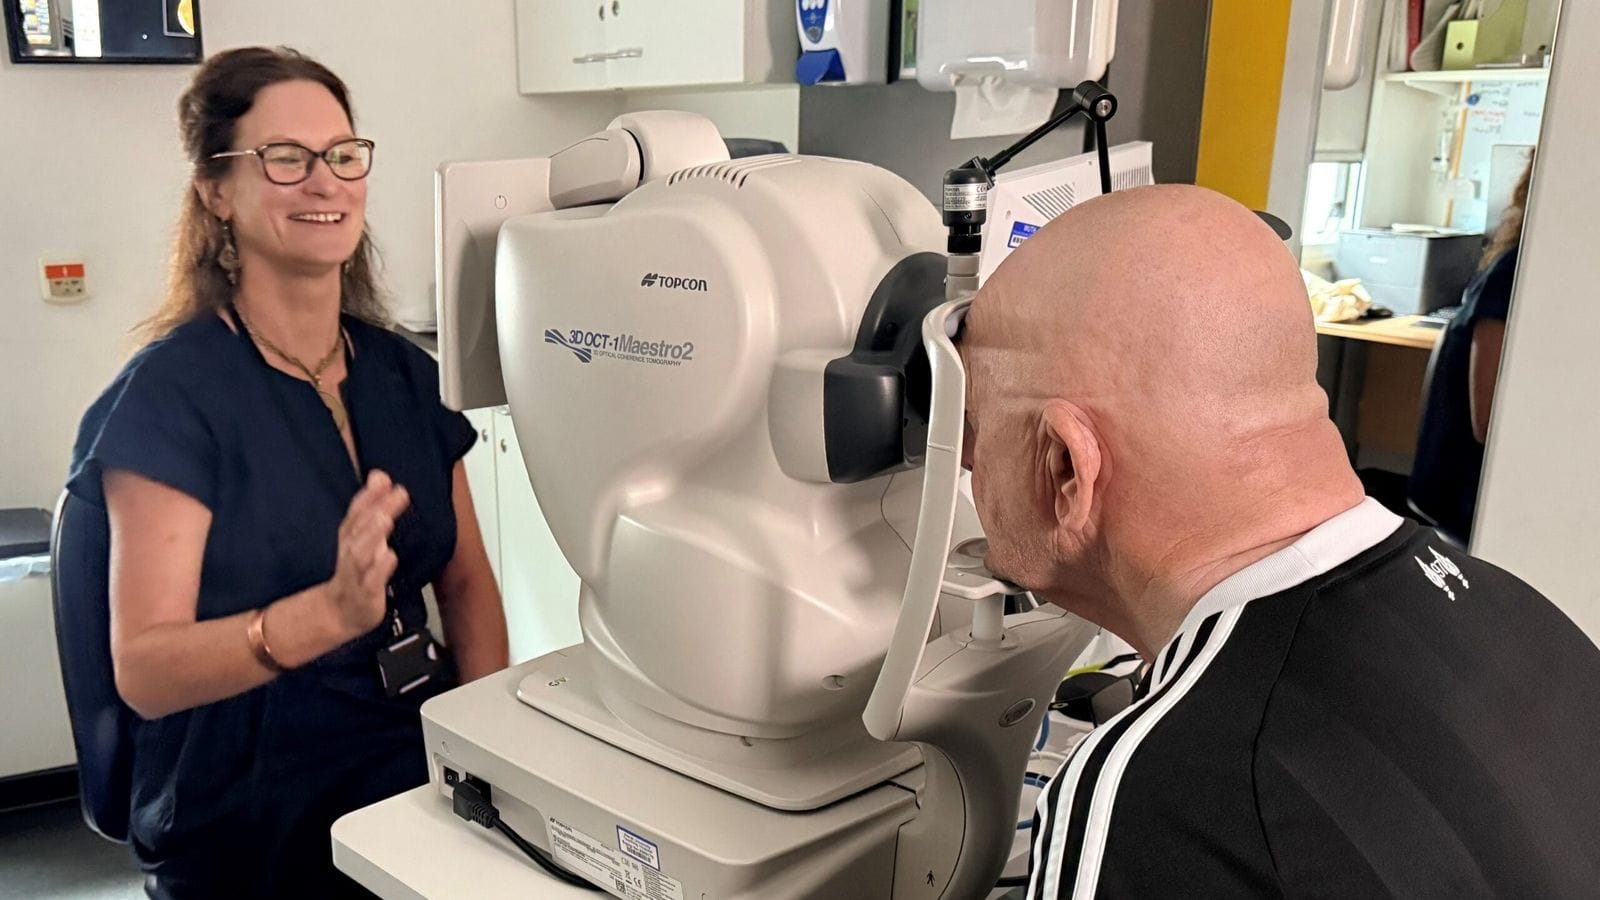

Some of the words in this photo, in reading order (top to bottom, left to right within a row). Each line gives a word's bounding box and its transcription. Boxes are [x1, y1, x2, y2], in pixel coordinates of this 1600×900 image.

[658, 276, 708, 292] TOPCON
[568, 330, 584, 345] 3D
[600, 351, 617, 359] OPTICAL
[617, 353, 645, 363] COHERENCE
[646, 357, 682, 367] TOMOGRAPHY
